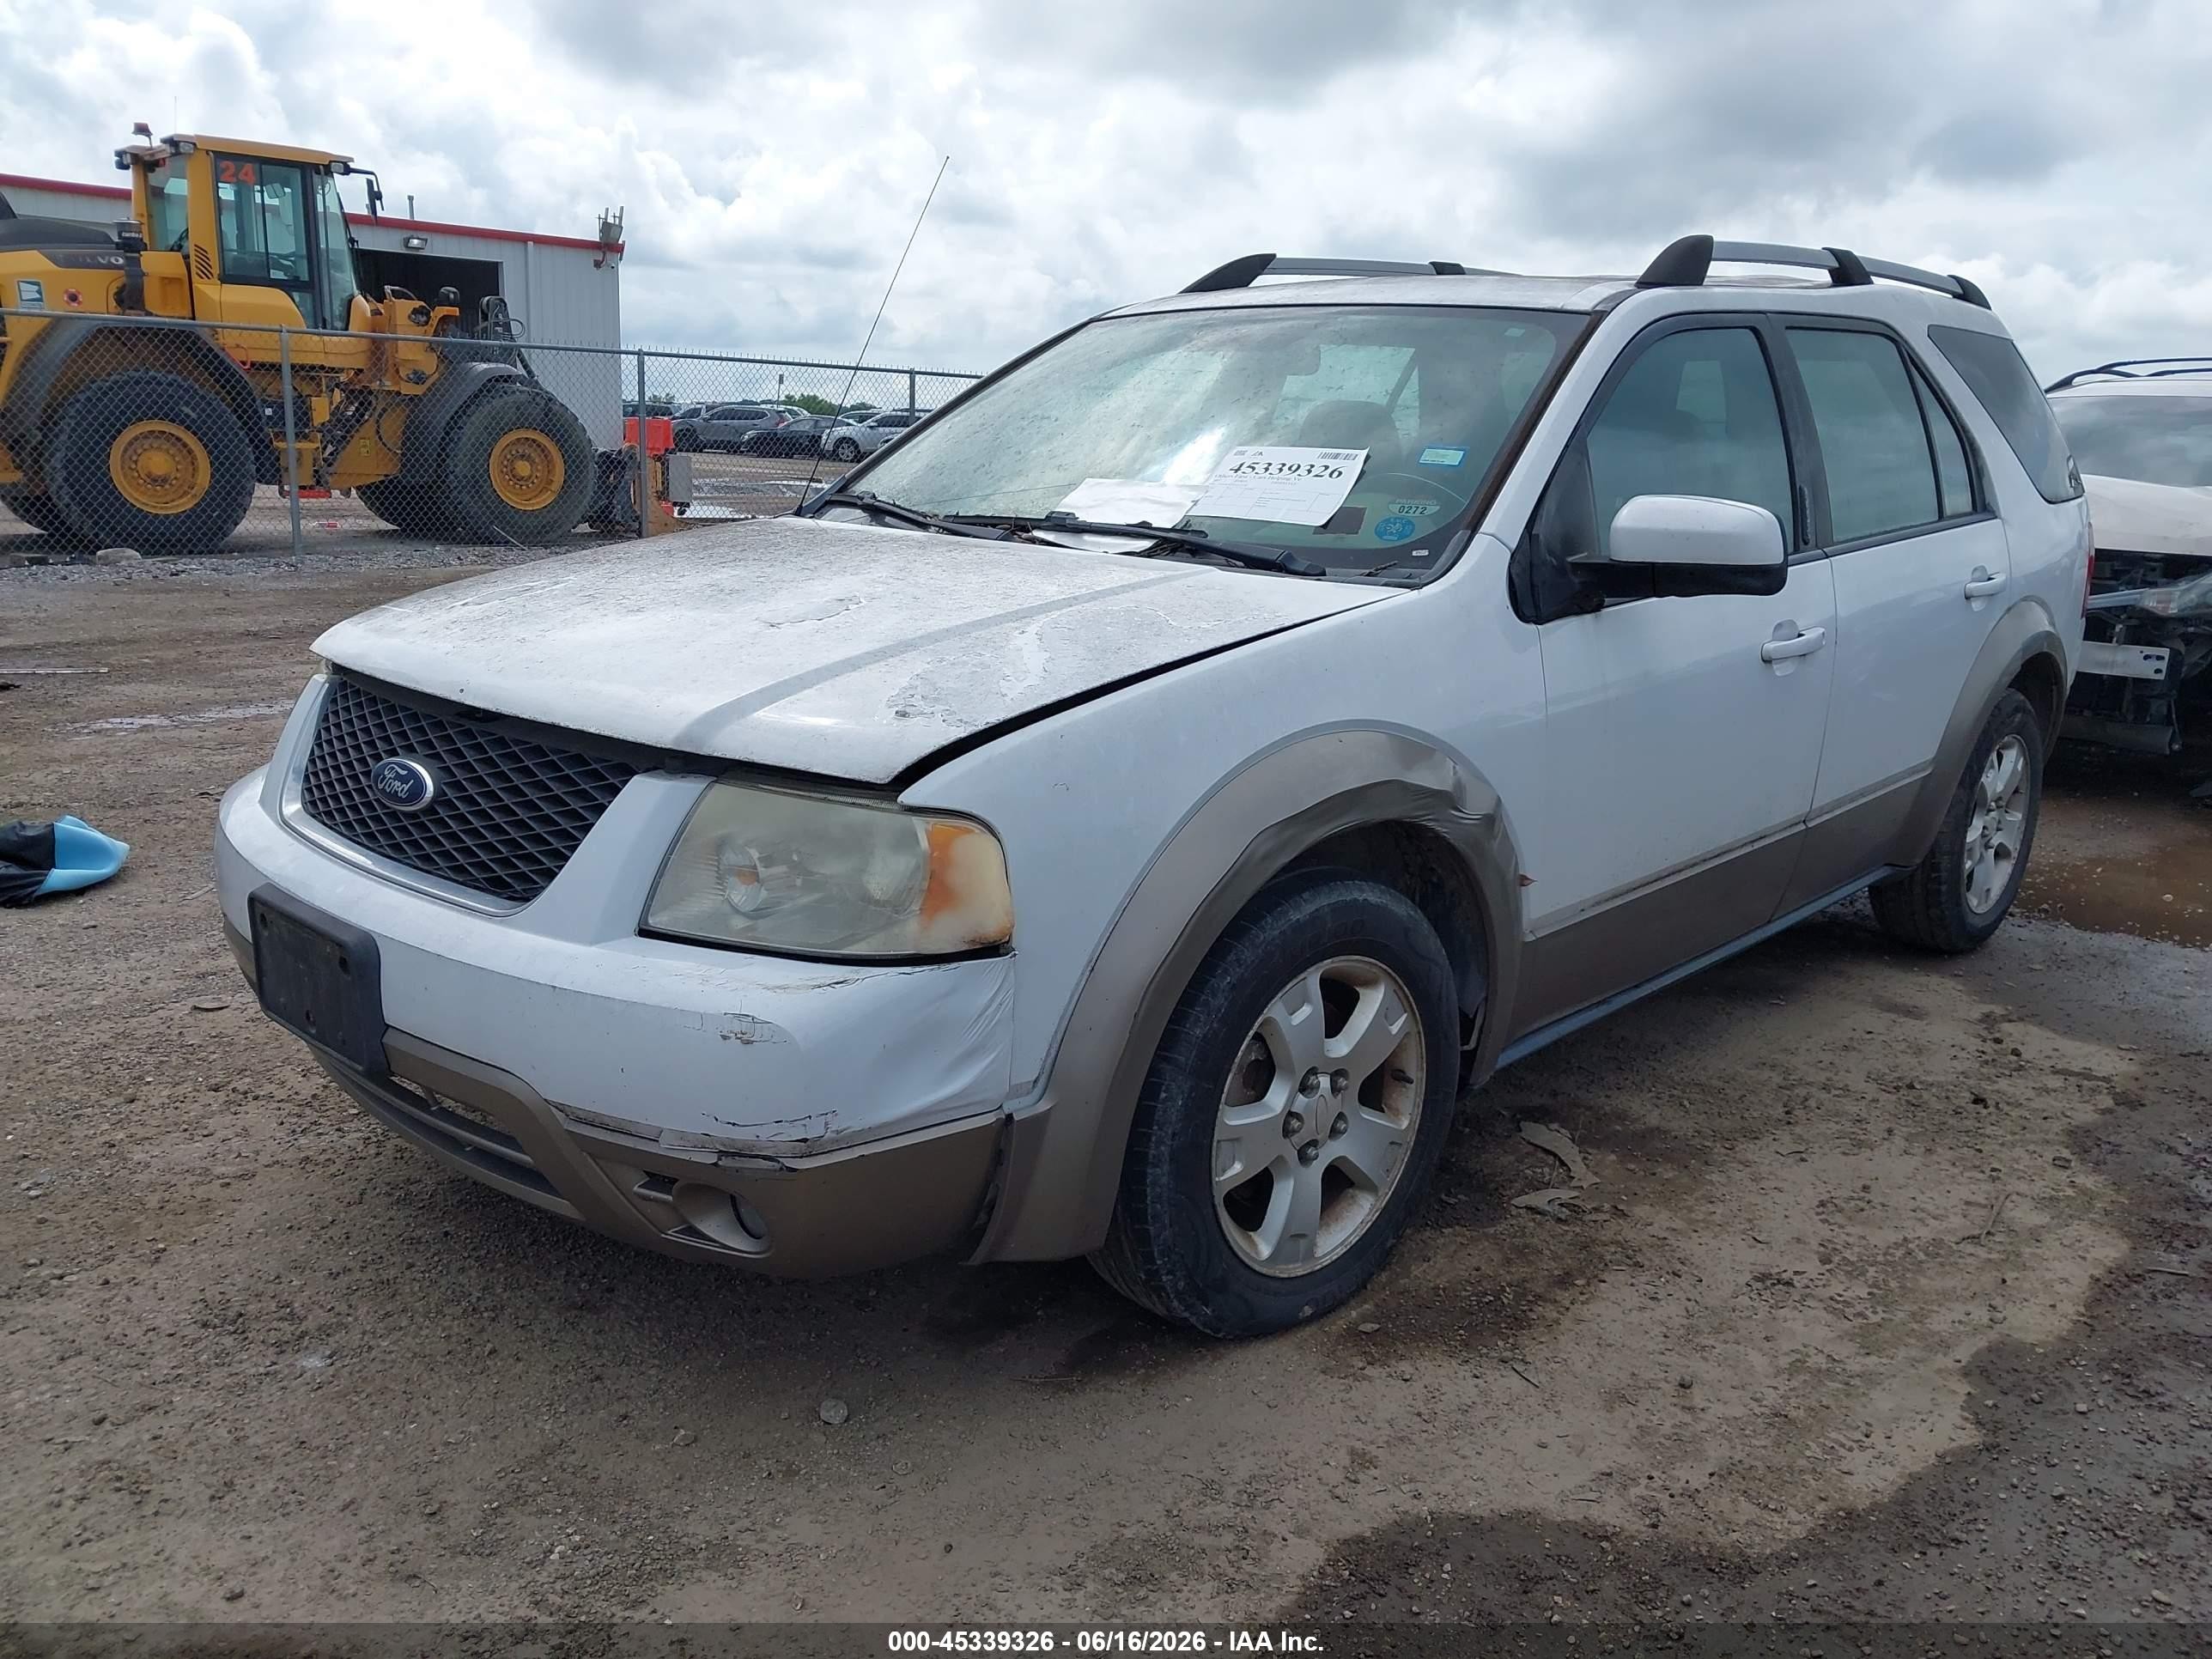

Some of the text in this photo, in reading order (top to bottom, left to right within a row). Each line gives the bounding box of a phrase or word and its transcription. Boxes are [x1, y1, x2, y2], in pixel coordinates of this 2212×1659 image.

[220, 161, 256, 185] 24
[1229, 460, 1347, 480] 45339326
[1398, 505, 1428, 515] 0272
[378, 763, 415, 799] Ford
